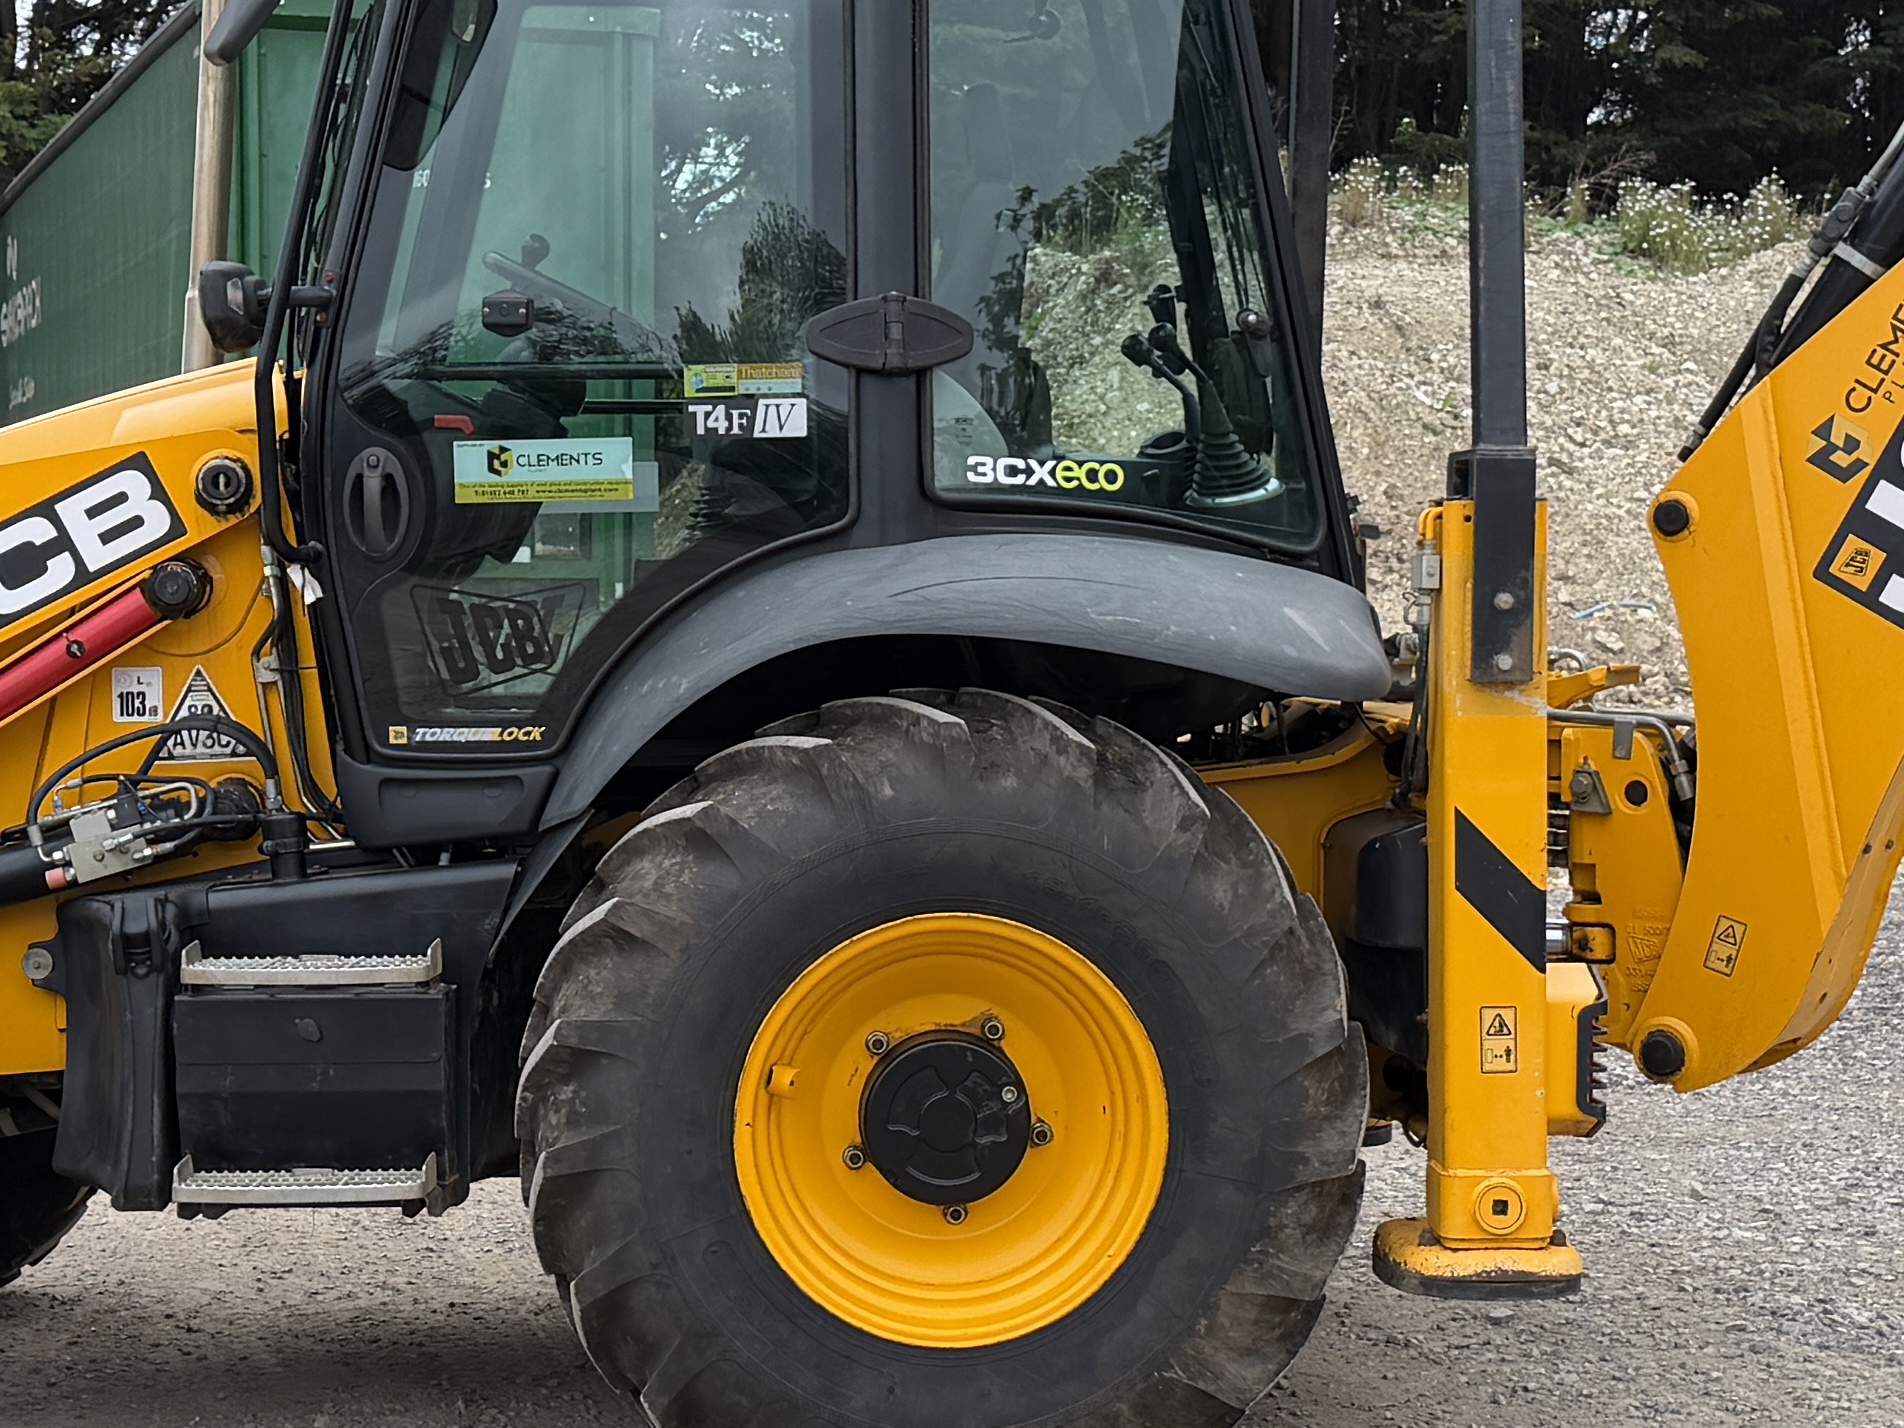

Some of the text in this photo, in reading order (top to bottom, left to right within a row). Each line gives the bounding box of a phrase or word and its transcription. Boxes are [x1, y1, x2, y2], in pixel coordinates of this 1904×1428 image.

[758, 403, 798, 434] IV
[516, 451, 603, 468] CLEMENTS
[436, 596, 546, 686] JCB
[116, 690, 146, 717] 103
